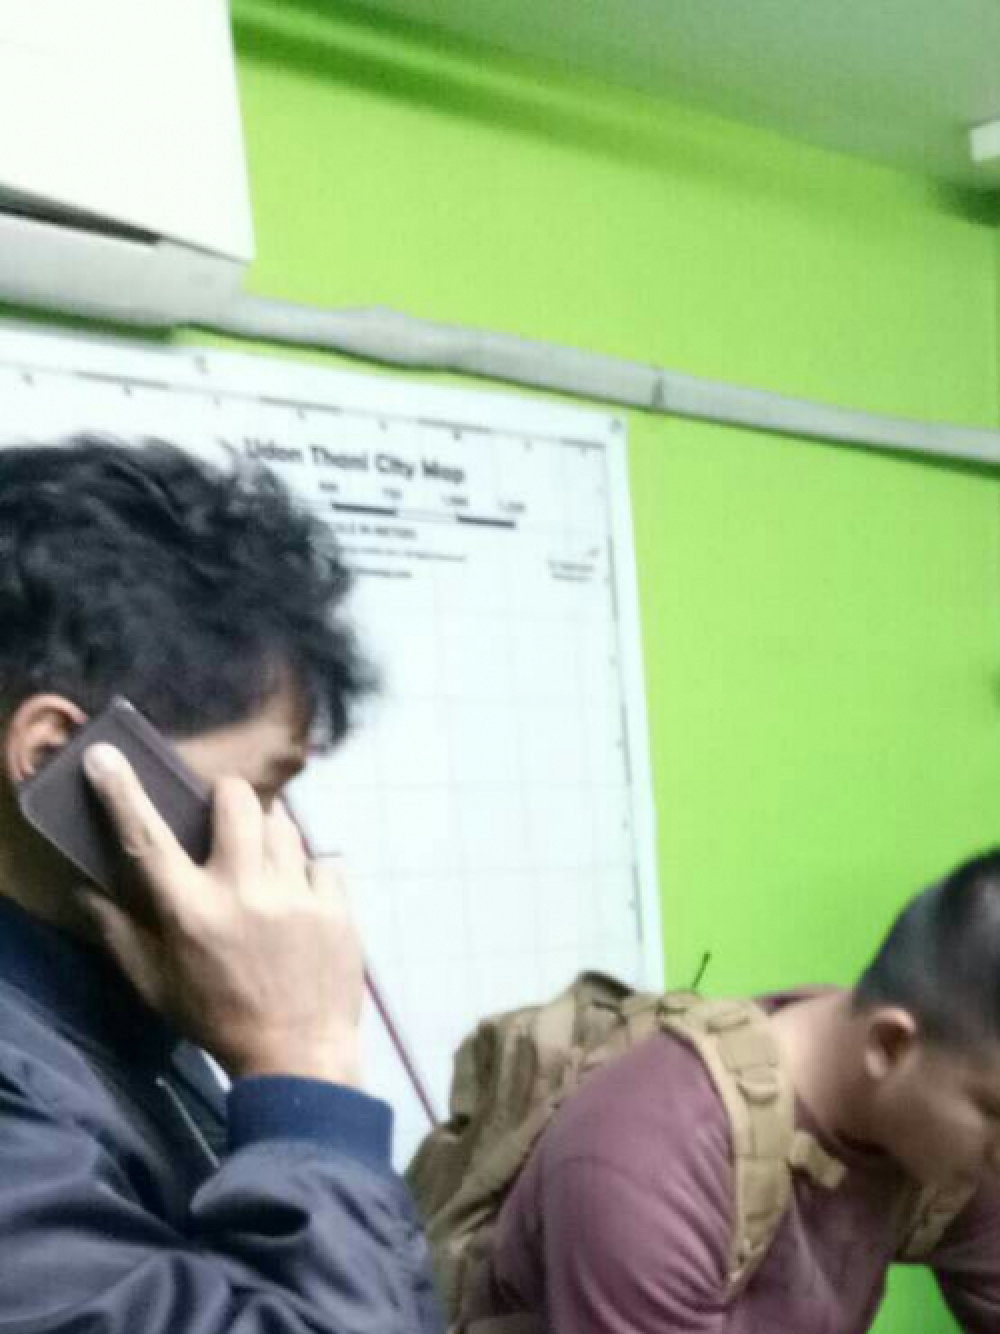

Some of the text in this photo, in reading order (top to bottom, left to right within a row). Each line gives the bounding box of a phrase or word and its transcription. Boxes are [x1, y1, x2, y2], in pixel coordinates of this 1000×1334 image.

[244, 436, 466, 484] Udon Thani City Map
